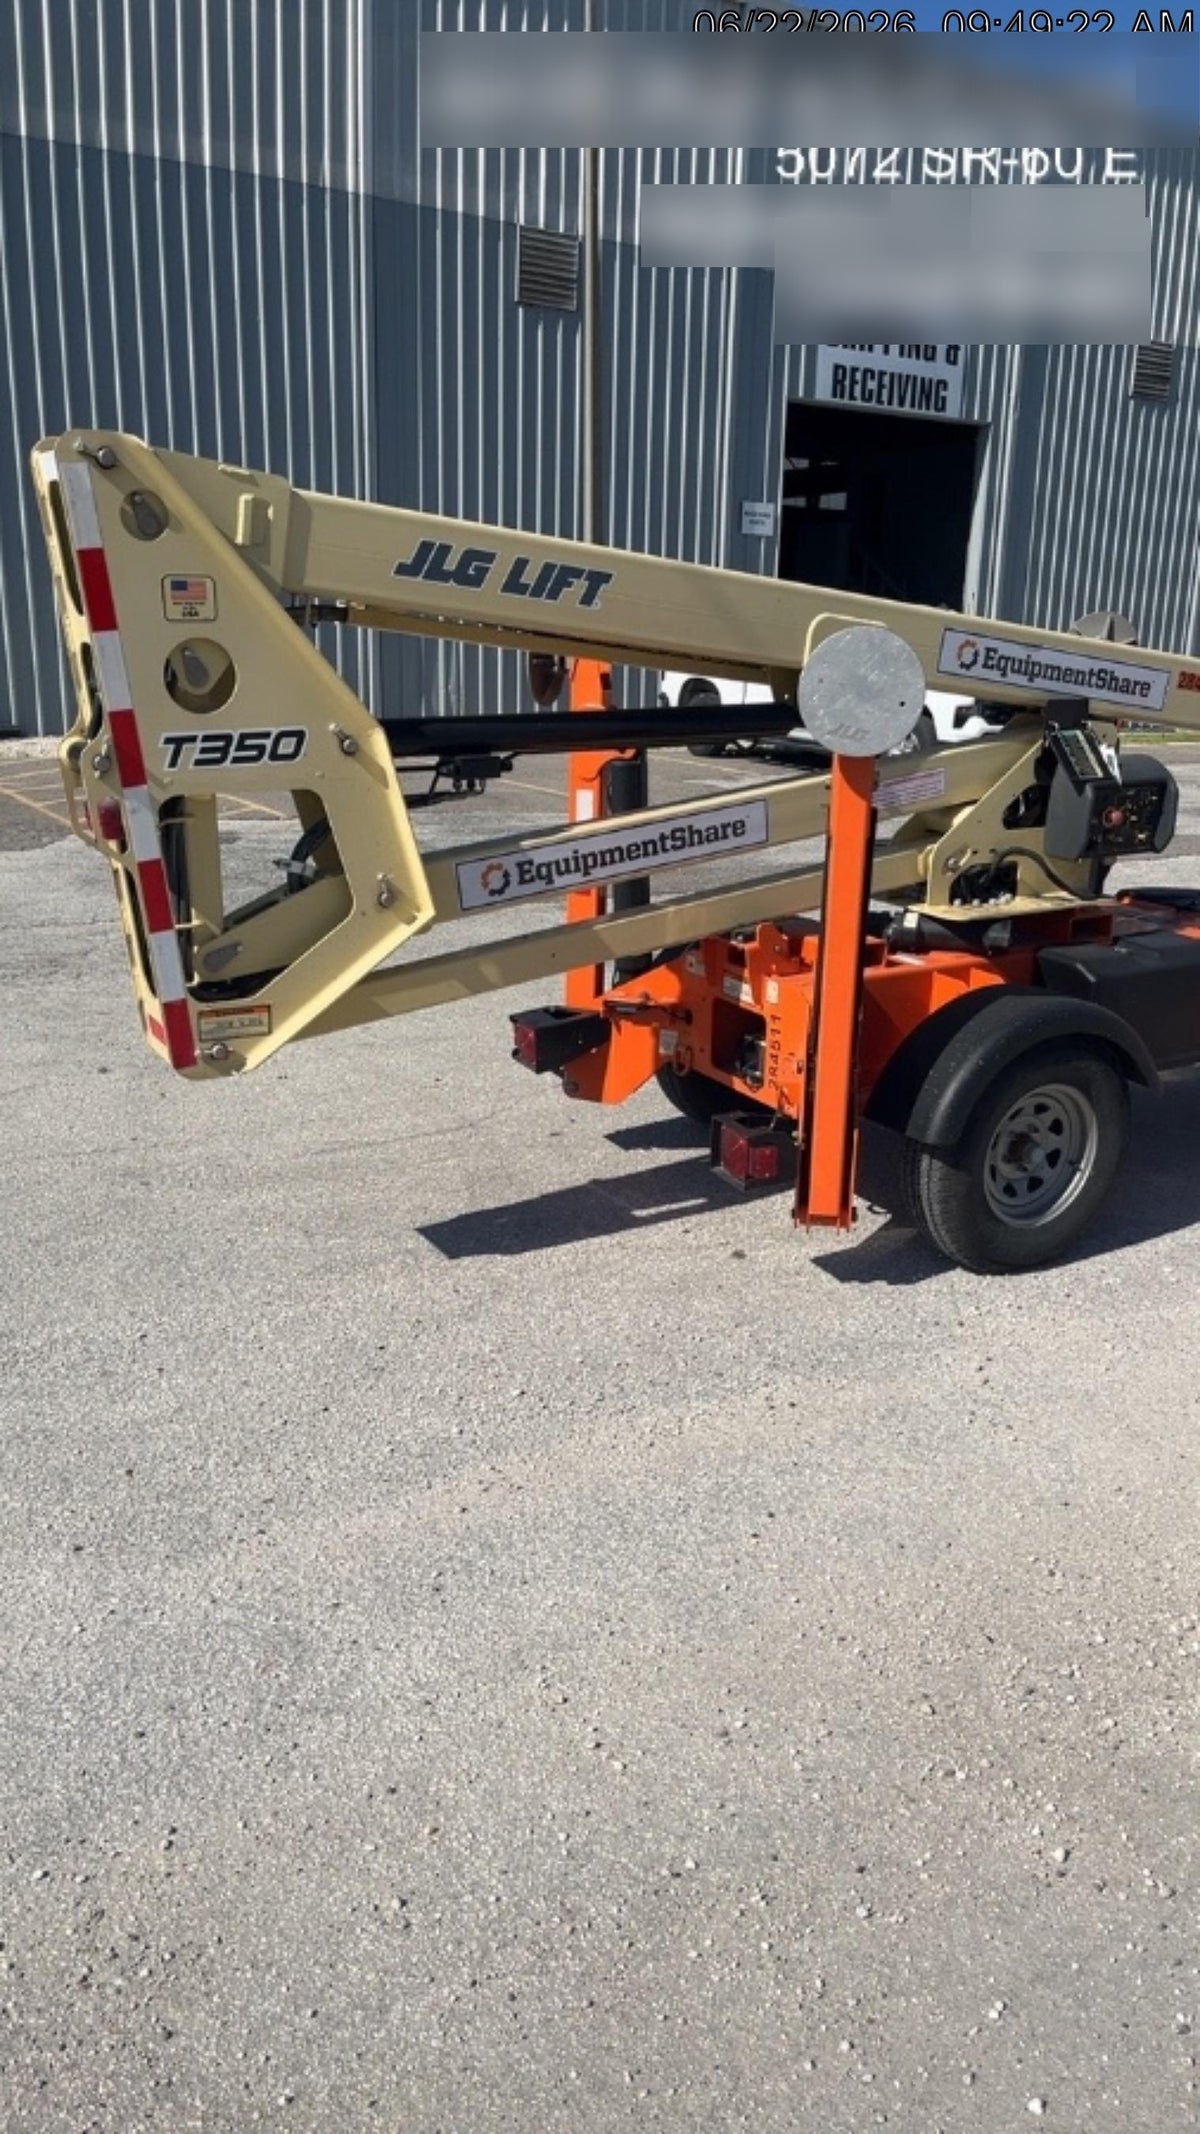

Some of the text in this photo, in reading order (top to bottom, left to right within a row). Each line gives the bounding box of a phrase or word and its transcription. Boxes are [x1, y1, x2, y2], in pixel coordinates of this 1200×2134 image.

[831, 363, 949, 413] RECEIVING
[392, 538, 614, 609] JLG LIFT
[981, 646, 1151, 699] EquipmentShare
[160, 728, 308, 769] T350
[515, 817, 747, 887] EquipmentShare
